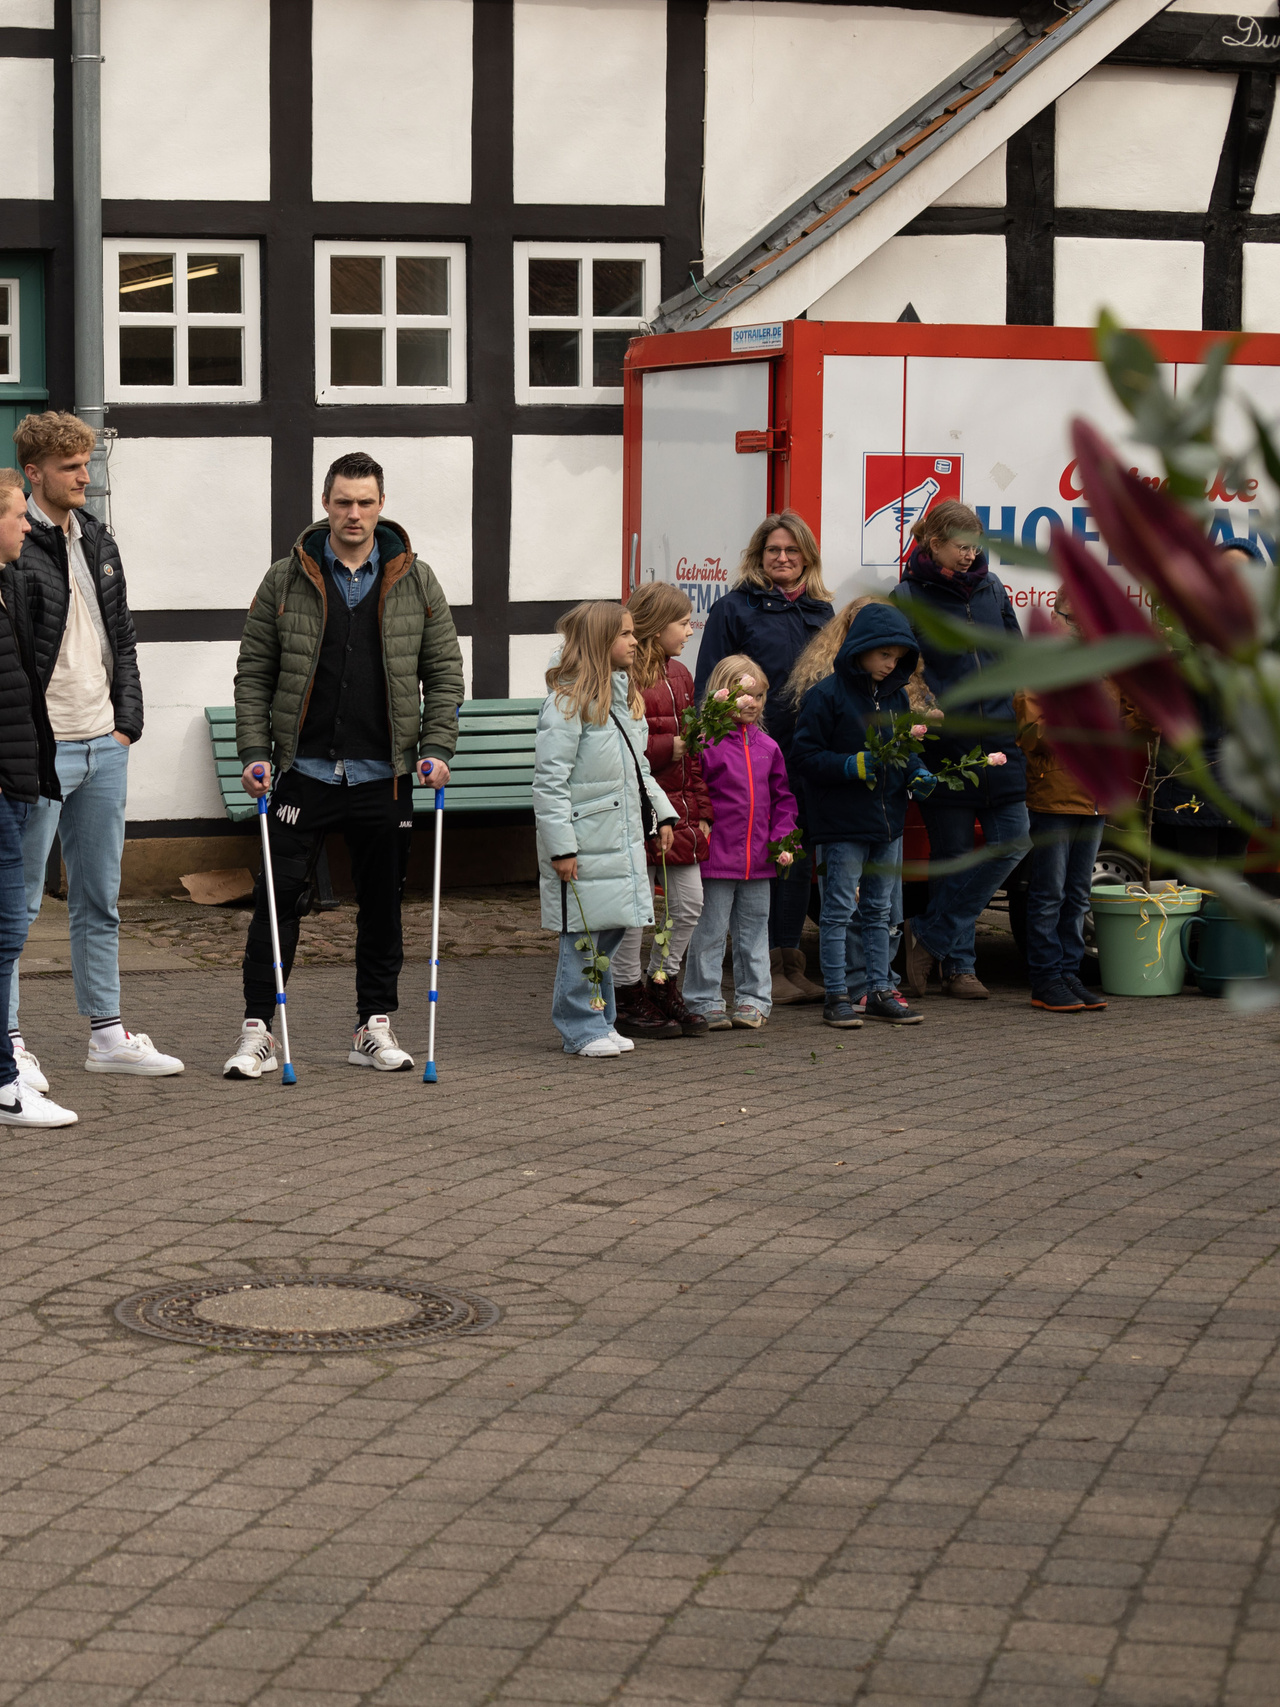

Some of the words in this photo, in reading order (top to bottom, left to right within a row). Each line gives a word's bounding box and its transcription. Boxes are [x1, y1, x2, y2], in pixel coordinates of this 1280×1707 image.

[733, 326, 781, 340] ISOTRAILER.DE
[676, 557, 728, 581] Getränke
[276, 804, 300, 825] MW
